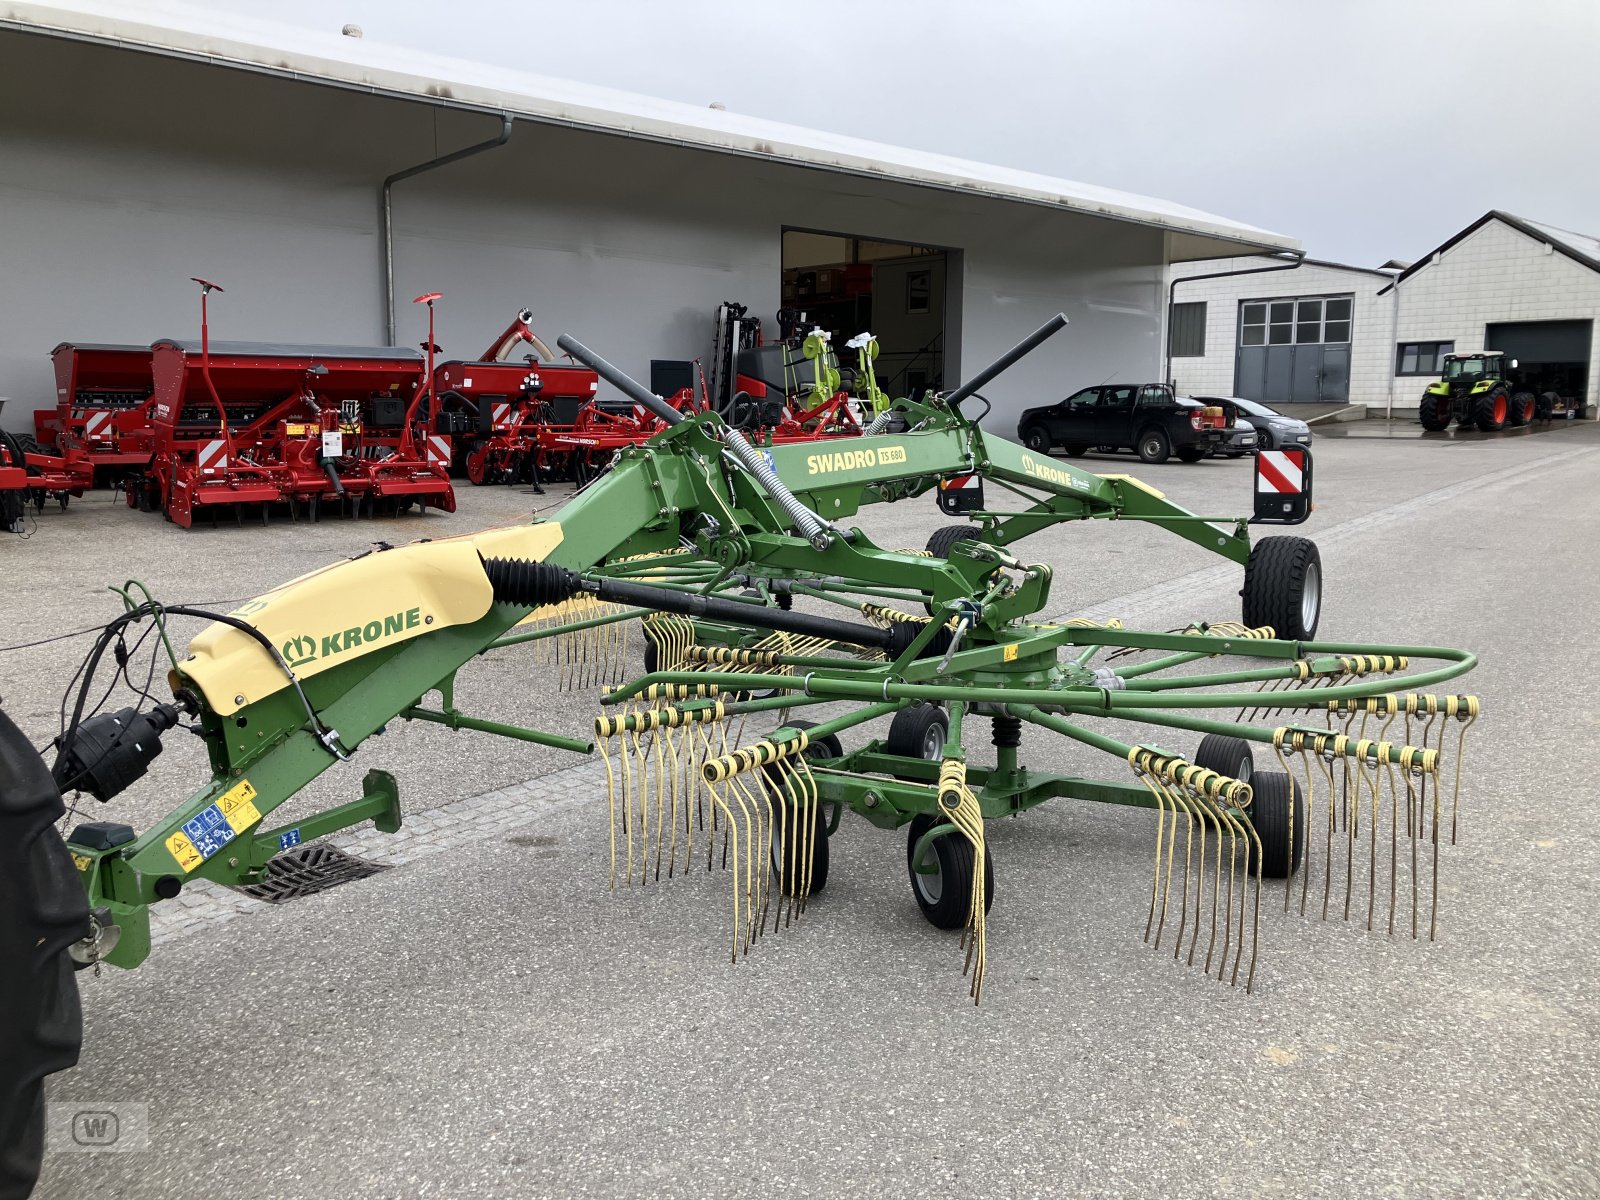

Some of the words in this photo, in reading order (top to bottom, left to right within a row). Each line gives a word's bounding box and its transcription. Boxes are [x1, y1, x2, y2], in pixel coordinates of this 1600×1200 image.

[807, 449, 876, 475] SWADRO
[880, 451, 890, 461] TS
[890, 449, 903, 461] 680
[1035, 463, 1072, 487] KRONE
[321, 606, 421, 658] KRONE
